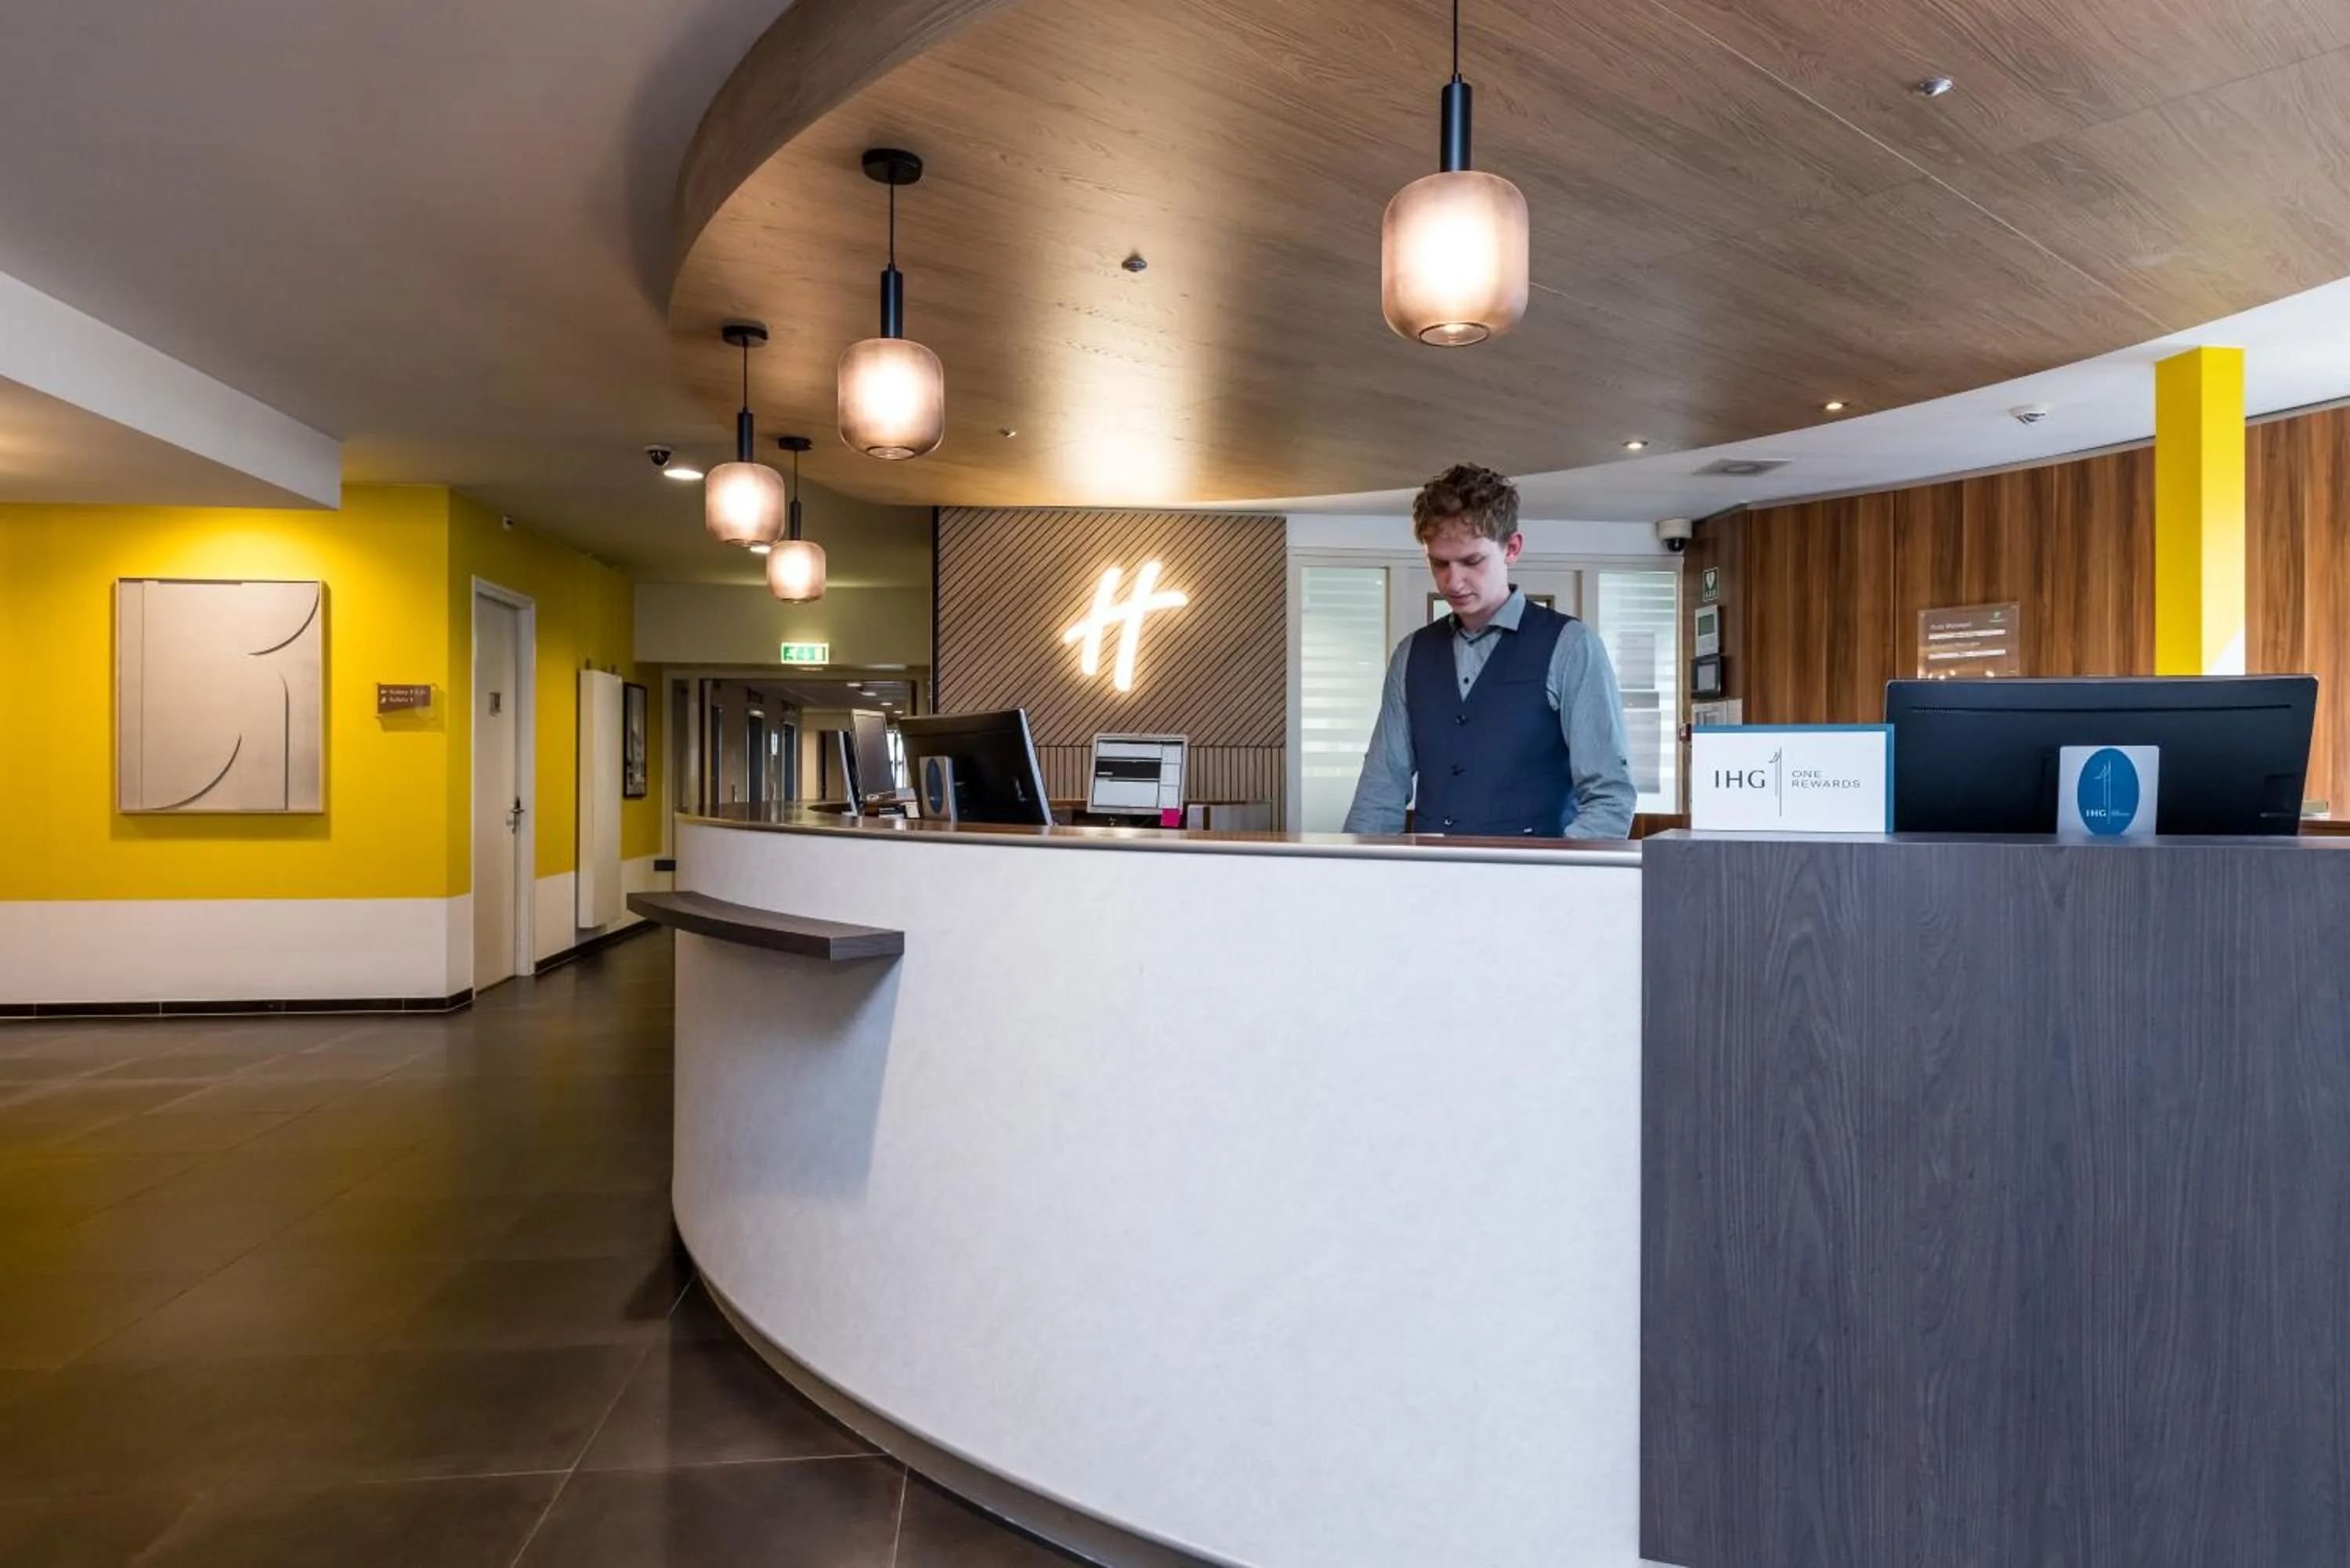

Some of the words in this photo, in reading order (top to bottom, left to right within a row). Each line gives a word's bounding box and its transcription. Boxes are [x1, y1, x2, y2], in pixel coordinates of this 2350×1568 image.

[1715, 770, 1766, 789] IHG
[1791, 770, 1823, 779] ONE
[1791, 779, 1861, 789] REWARDS
